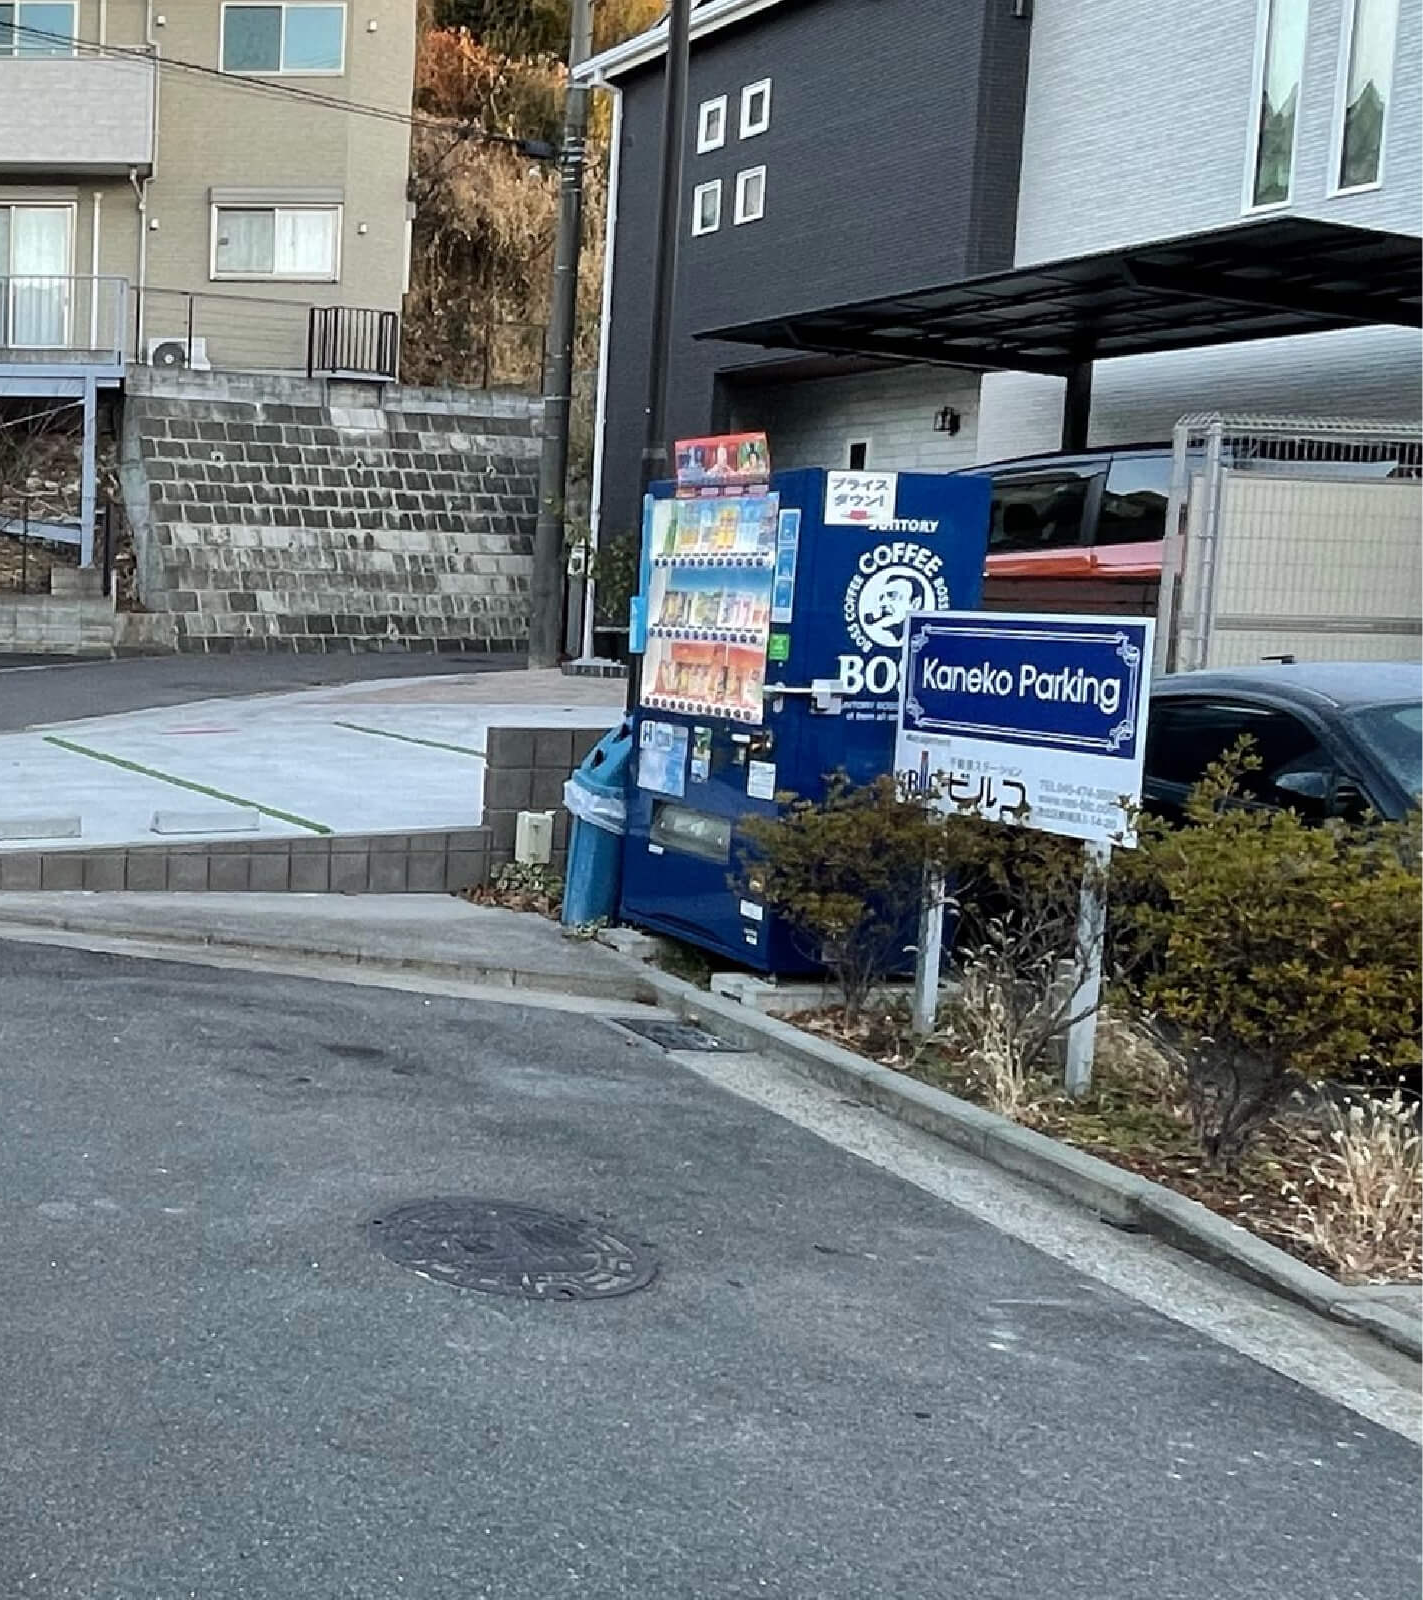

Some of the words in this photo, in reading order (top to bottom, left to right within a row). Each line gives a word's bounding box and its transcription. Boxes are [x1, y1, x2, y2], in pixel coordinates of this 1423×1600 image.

[833, 477, 889, 491] プライス
[859, 542, 943, 577] COFFEE
[838, 655, 903, 694] BO
[922, 657, 1014, 696] Kaneko
[1019, 664, 1121, 714] Parking
